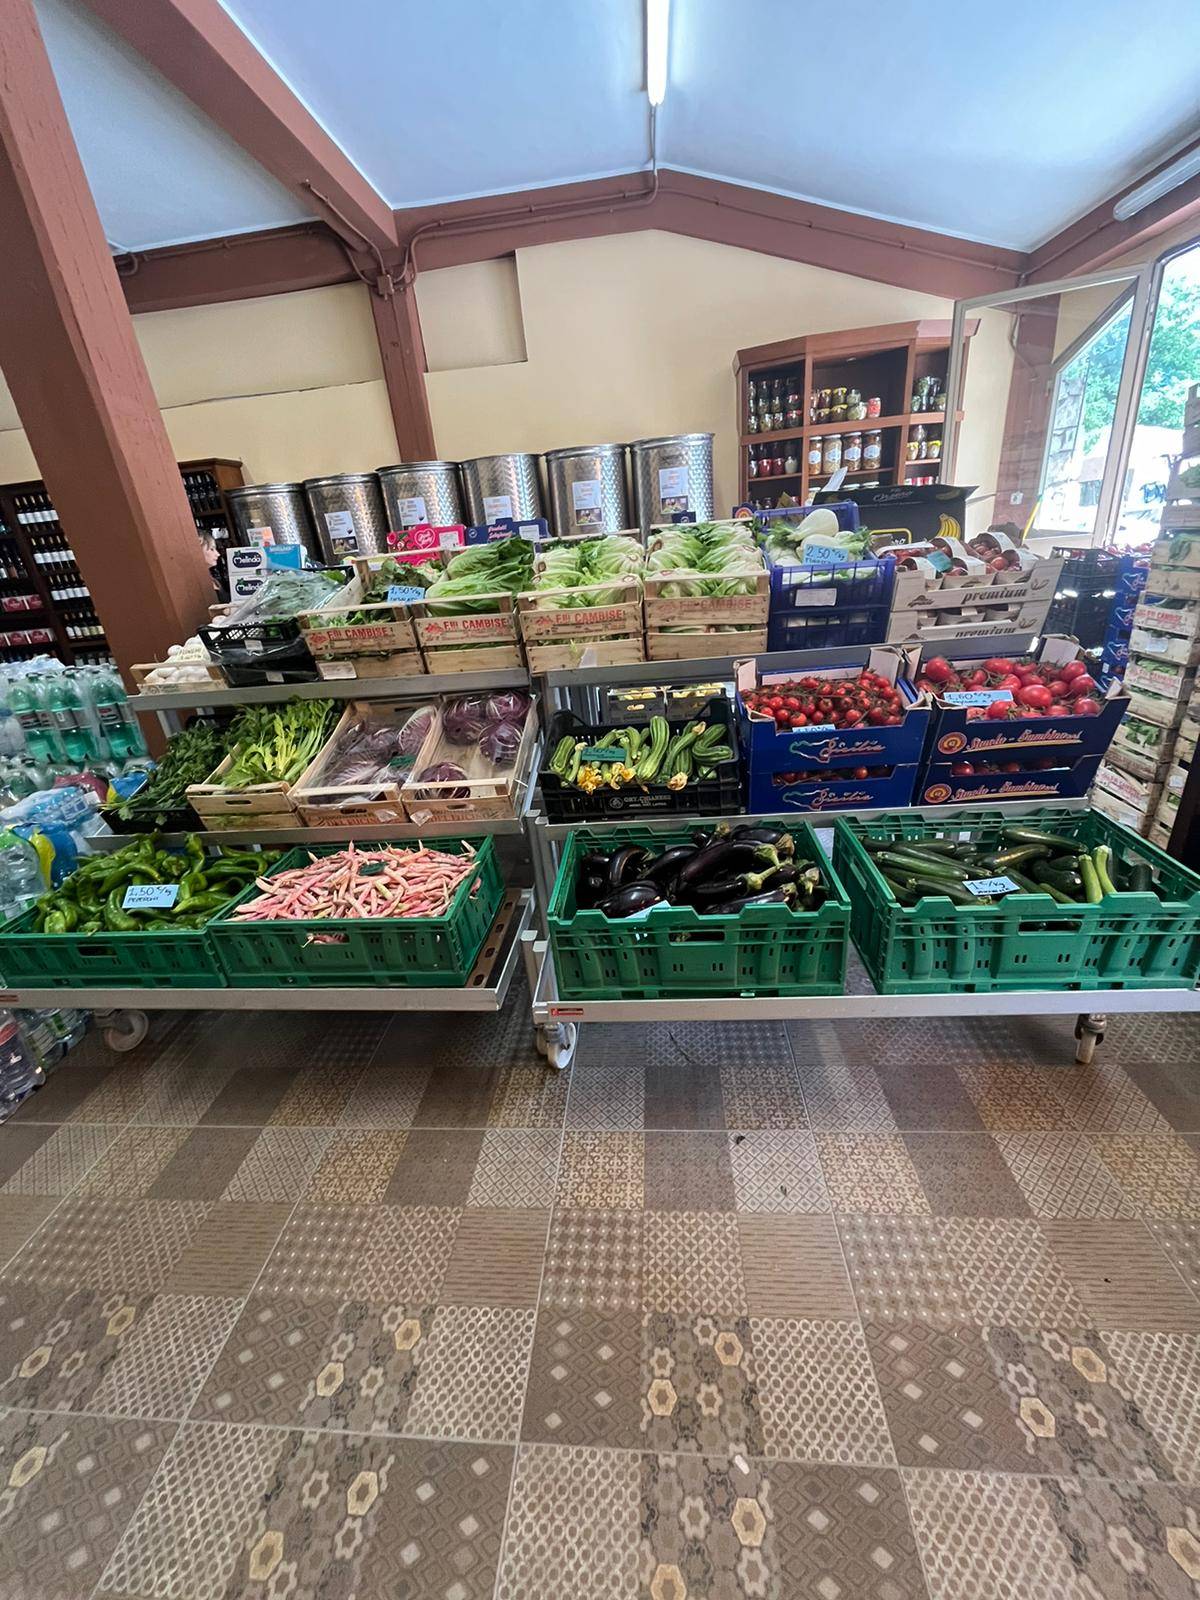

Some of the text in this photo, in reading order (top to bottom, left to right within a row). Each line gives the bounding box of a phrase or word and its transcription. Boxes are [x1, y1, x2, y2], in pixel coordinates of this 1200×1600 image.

[961, 587, 1028, 604] premium
[574, 609, 622, 624] CAMBISE
[462, 618, 507, 629] CAMBISE
[345, 626, 388, 639] CAMBISE
[128, 886, 155, 897] 1,50
